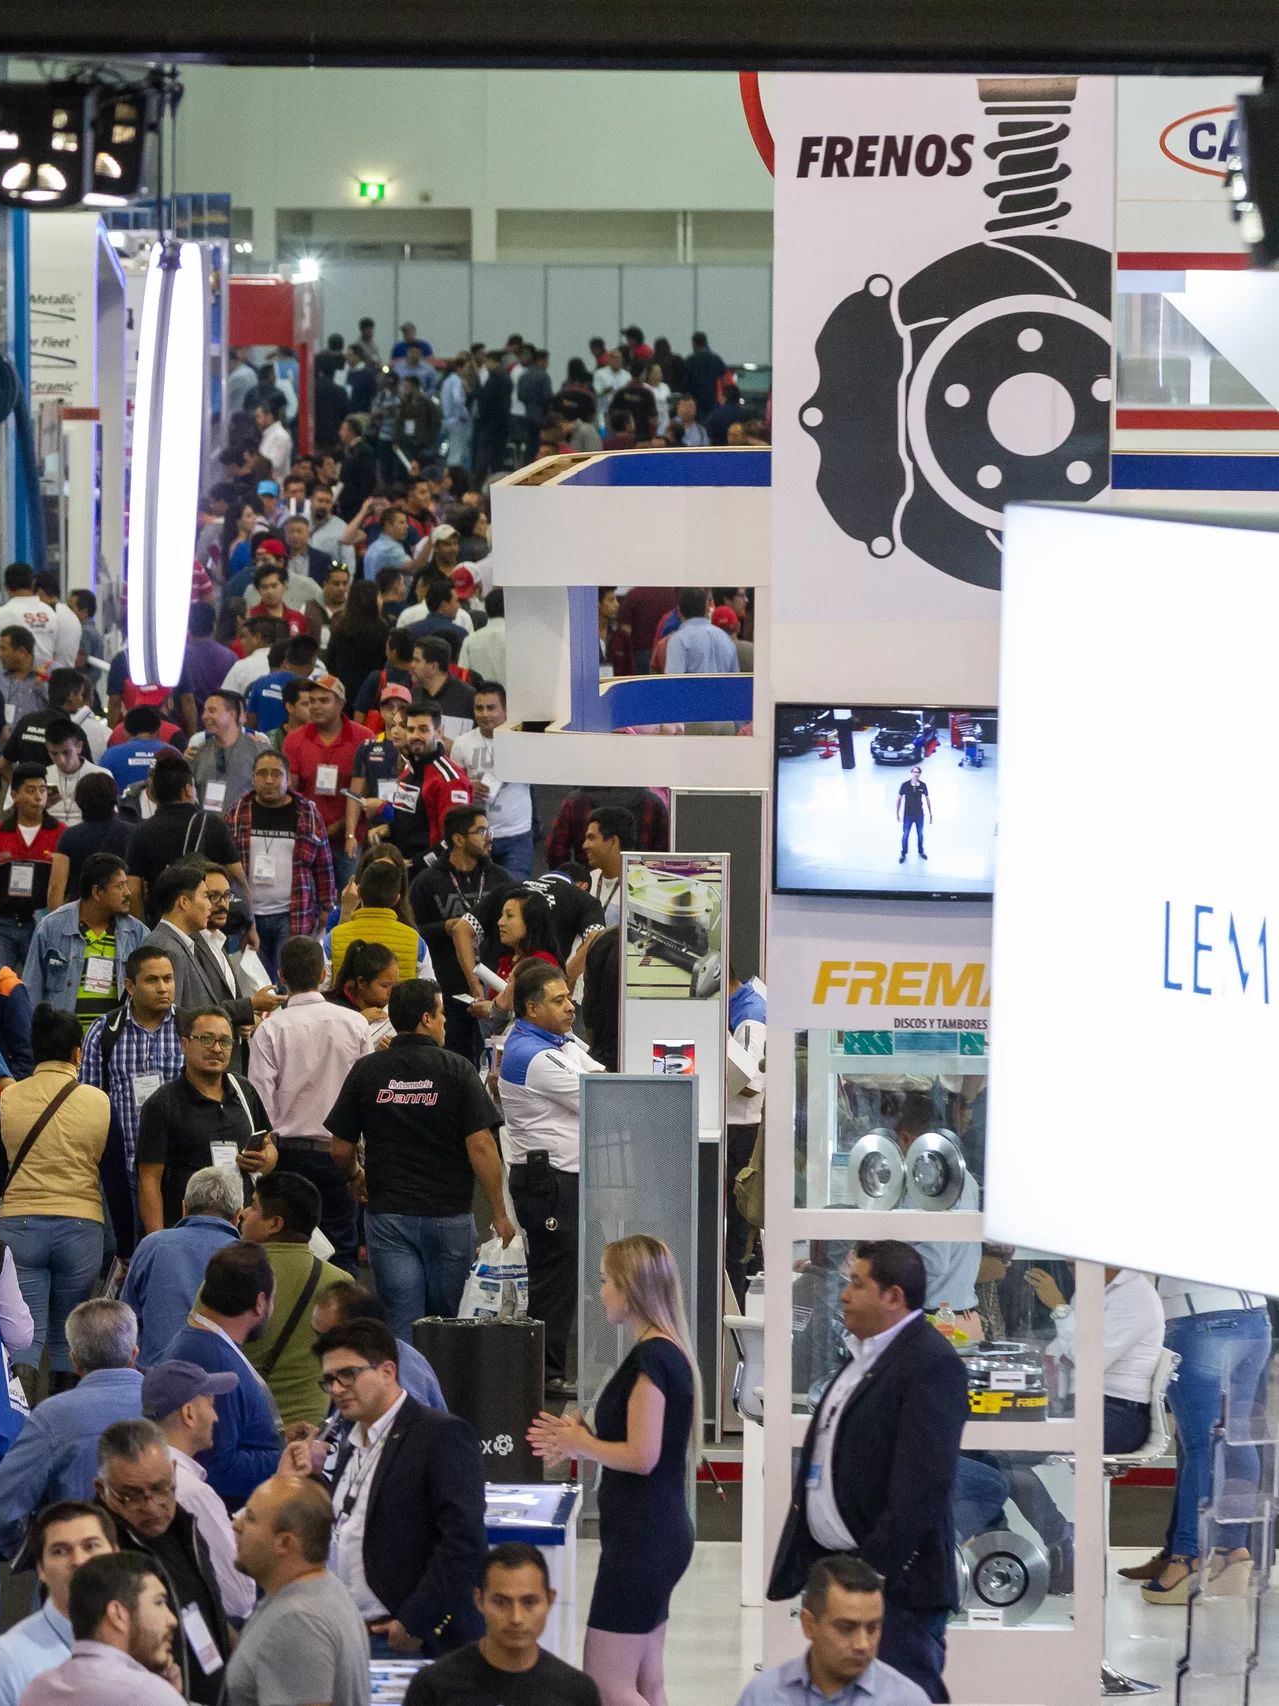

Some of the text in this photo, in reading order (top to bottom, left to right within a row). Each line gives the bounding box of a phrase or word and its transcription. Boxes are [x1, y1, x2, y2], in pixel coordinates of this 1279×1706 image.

[797, 134, 974, 178] FRENOS
[894, 1018, 988, 1029] DISCOS Y TAMBORES
[388, 1079, 433, 1089] Automotriz
[376, 1089, 438, 1106] Danny
